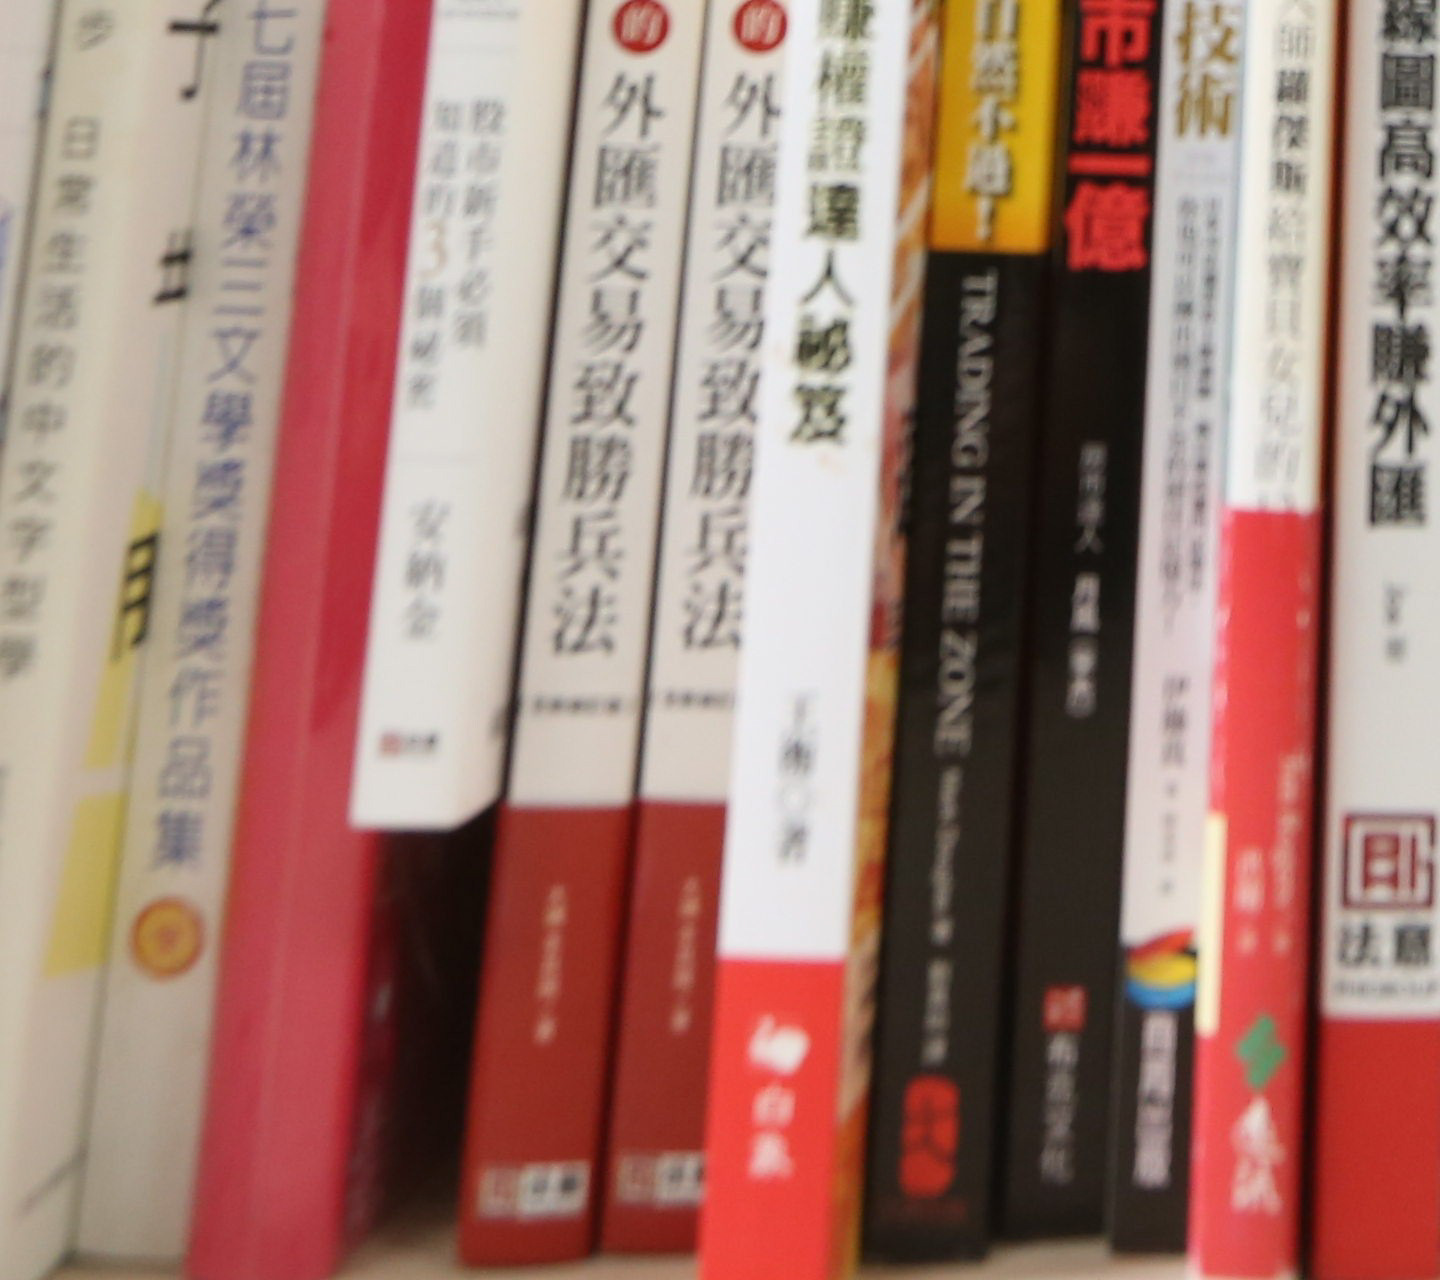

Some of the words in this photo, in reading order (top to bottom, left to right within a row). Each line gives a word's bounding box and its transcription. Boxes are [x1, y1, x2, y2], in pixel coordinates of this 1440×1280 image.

[952, 265, 999, 469] TRADING
[946, 472, 990, 528] IN
[941, 529, 985, 626] THE
[934, 628, 980, 758] ZONE
